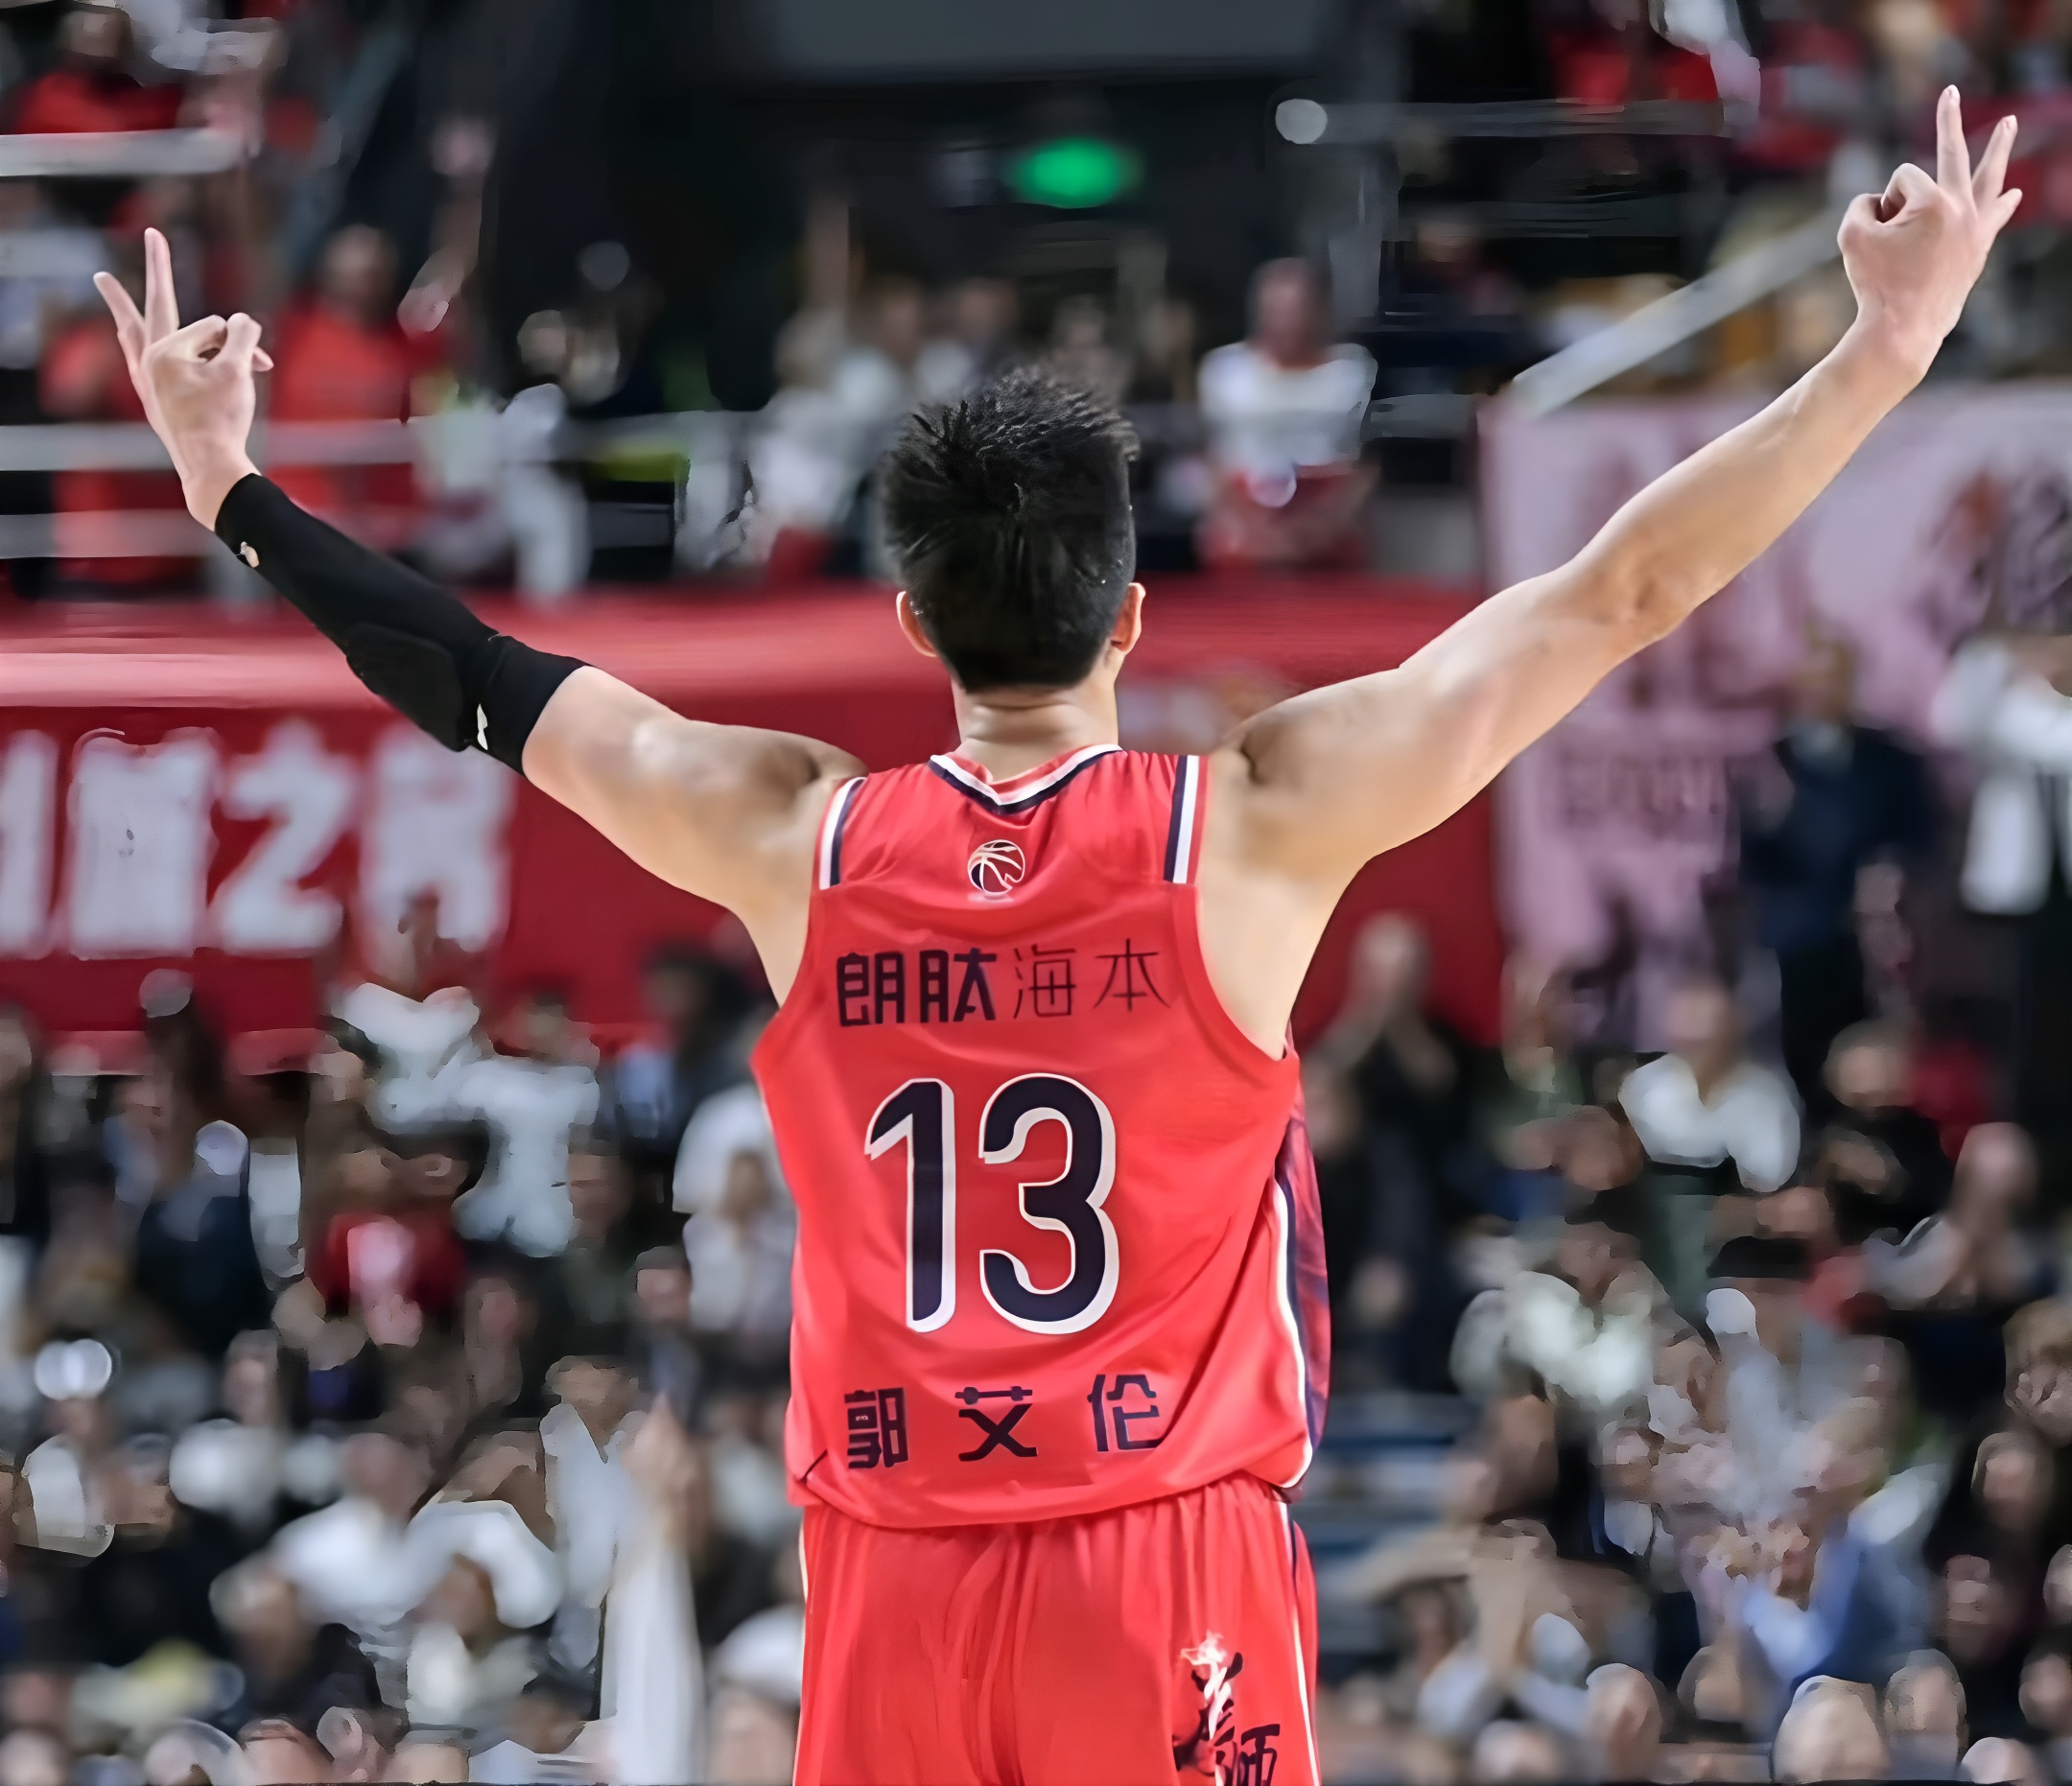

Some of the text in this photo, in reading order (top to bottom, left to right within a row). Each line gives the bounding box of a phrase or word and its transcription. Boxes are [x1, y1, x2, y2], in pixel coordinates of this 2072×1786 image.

[837, 939, 1169, 1026] 朗肽海本
[864, 1072, 1120, 1335] 13
[844, 1375, 1164, 1469] 郭艾伦
